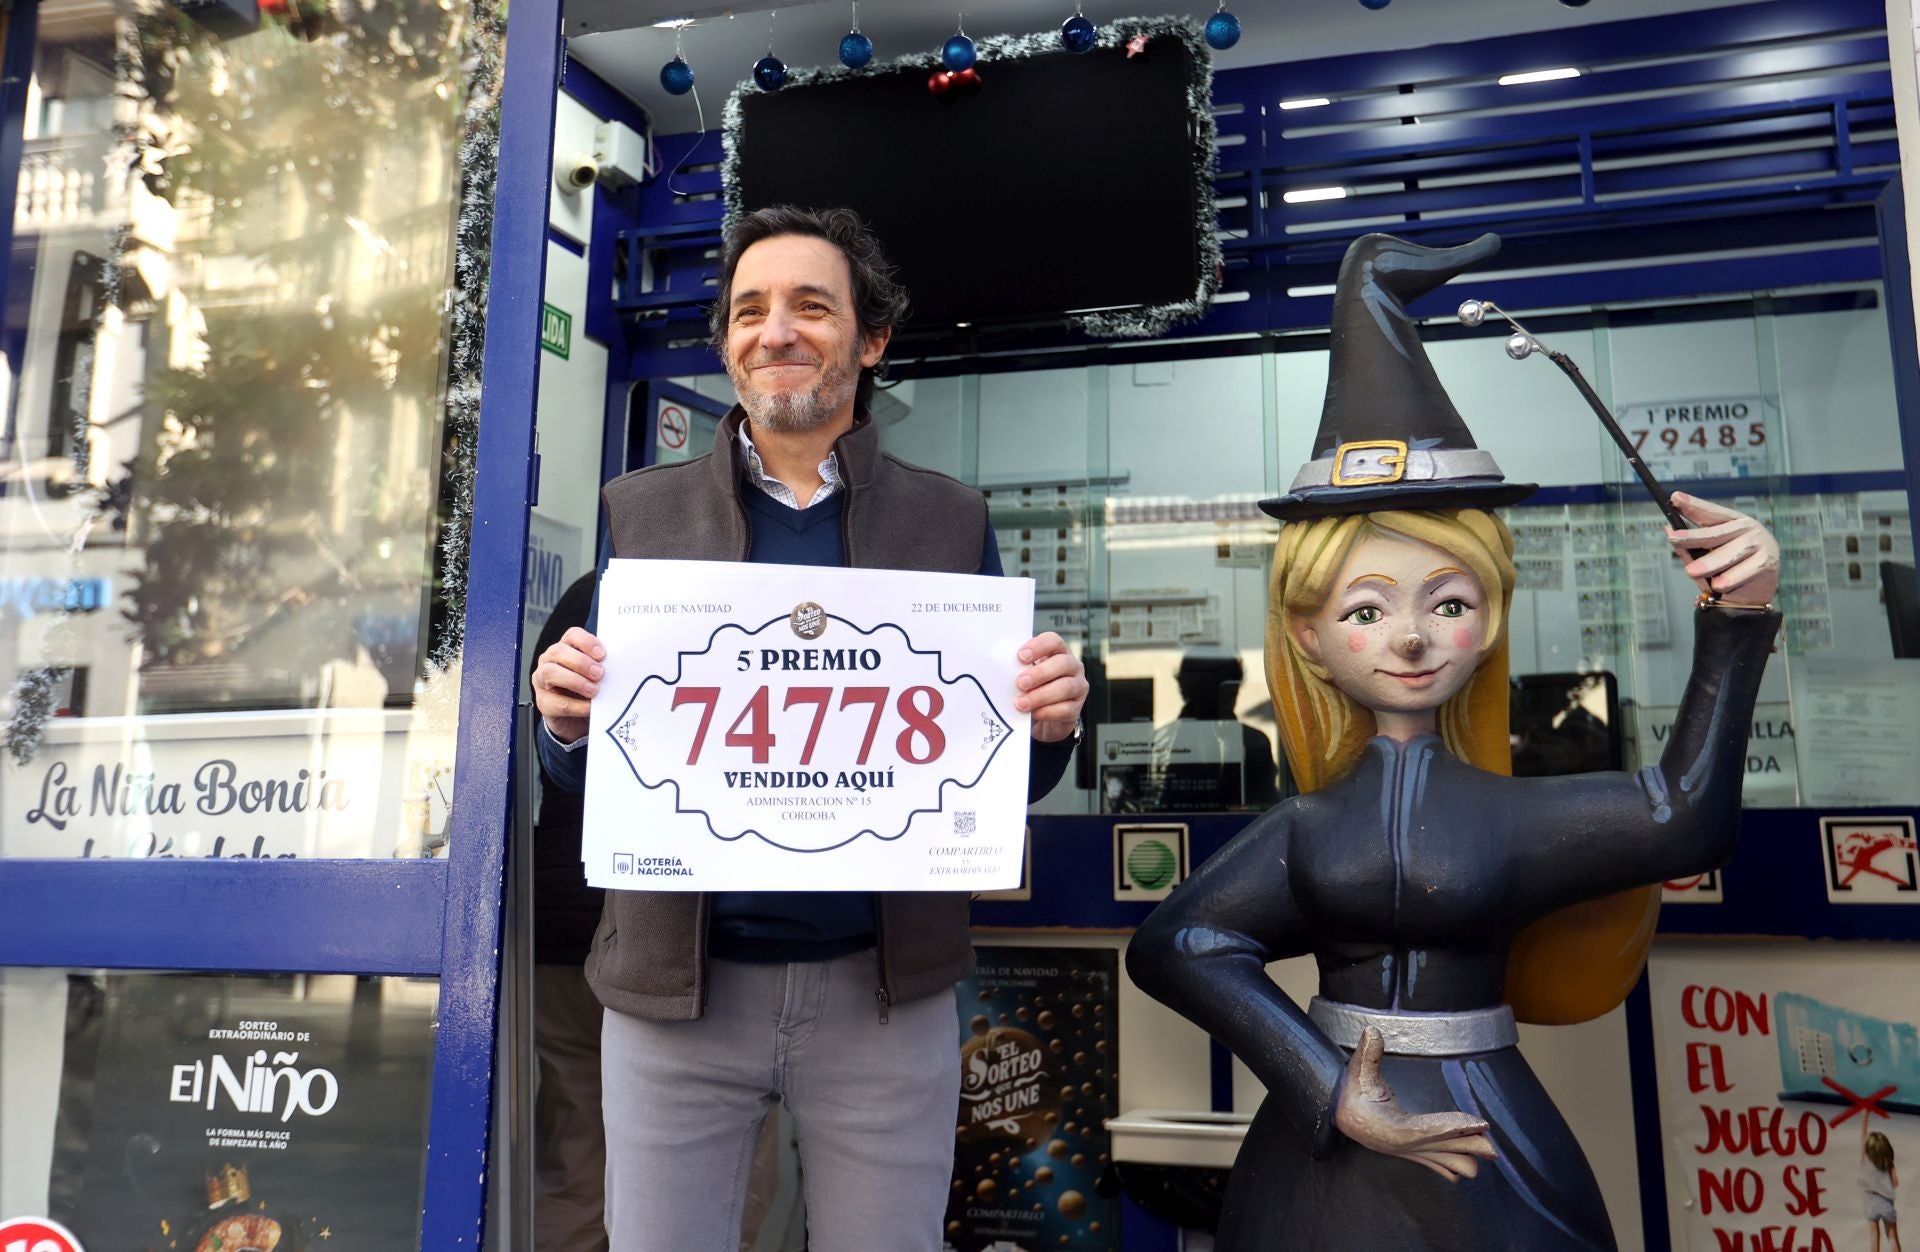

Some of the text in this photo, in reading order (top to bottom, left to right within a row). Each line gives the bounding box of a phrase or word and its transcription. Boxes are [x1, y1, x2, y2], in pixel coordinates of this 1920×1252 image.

[542, 309, 566, 349] LIDA
[1664, 403, 1749, 422] PREMIO
[1630, 423, 1766, 452] 79485
[663, 604, 679, 613] DE
[681, 604, 732, 613] NAVIDAD
[911, 603, 1003, 613] 22 DE DICIEMBRE
[760, 648, 881, 671] PREMIO
[670, 685, 946, 766] 74778
[724, 766, 894, 792] VENDIDO AQUÍ
[27, 761, 81, 830] La
[89, 761, 185, 817] Niña
[747, 797, 843, 806] ADMINISTRACION
[861, 797, 872, 806] 15
[781, 811, 836, 820] CORDOBA
[638, 857, 682, 866] LOTERÍA
[638, 867, 694, 876] NACIONAL
[1013, 968, 1058, 977] NAVIDAD
[1682, 984, 1769, 1036] CON
[209, 1029, 310, 1041] EXTRAORDINARIO DE
[239, 1021, 277, 1031] SORTEO
[997, 1041, 1019, 1059] EL
[965, 1048, 1042, 1091] SORTEO
[1686, 1042, 1736, 1094] EL
[207, 1050, 338, 1123] Niño
[972, 1084, 1040, 1123] NOS UNE
[206, 1128, 216, 1136] LA
[217, 1128, 245, 1137] FORMA
[265, 1131, 291, 1140] DULCE
[1694, 1104, 1827, 1157] JUEGO
[209, 1137, 287, 1150] DE EMPEZAR EL AÑO
[1698, 1164, 1829, 1217] NO SE
